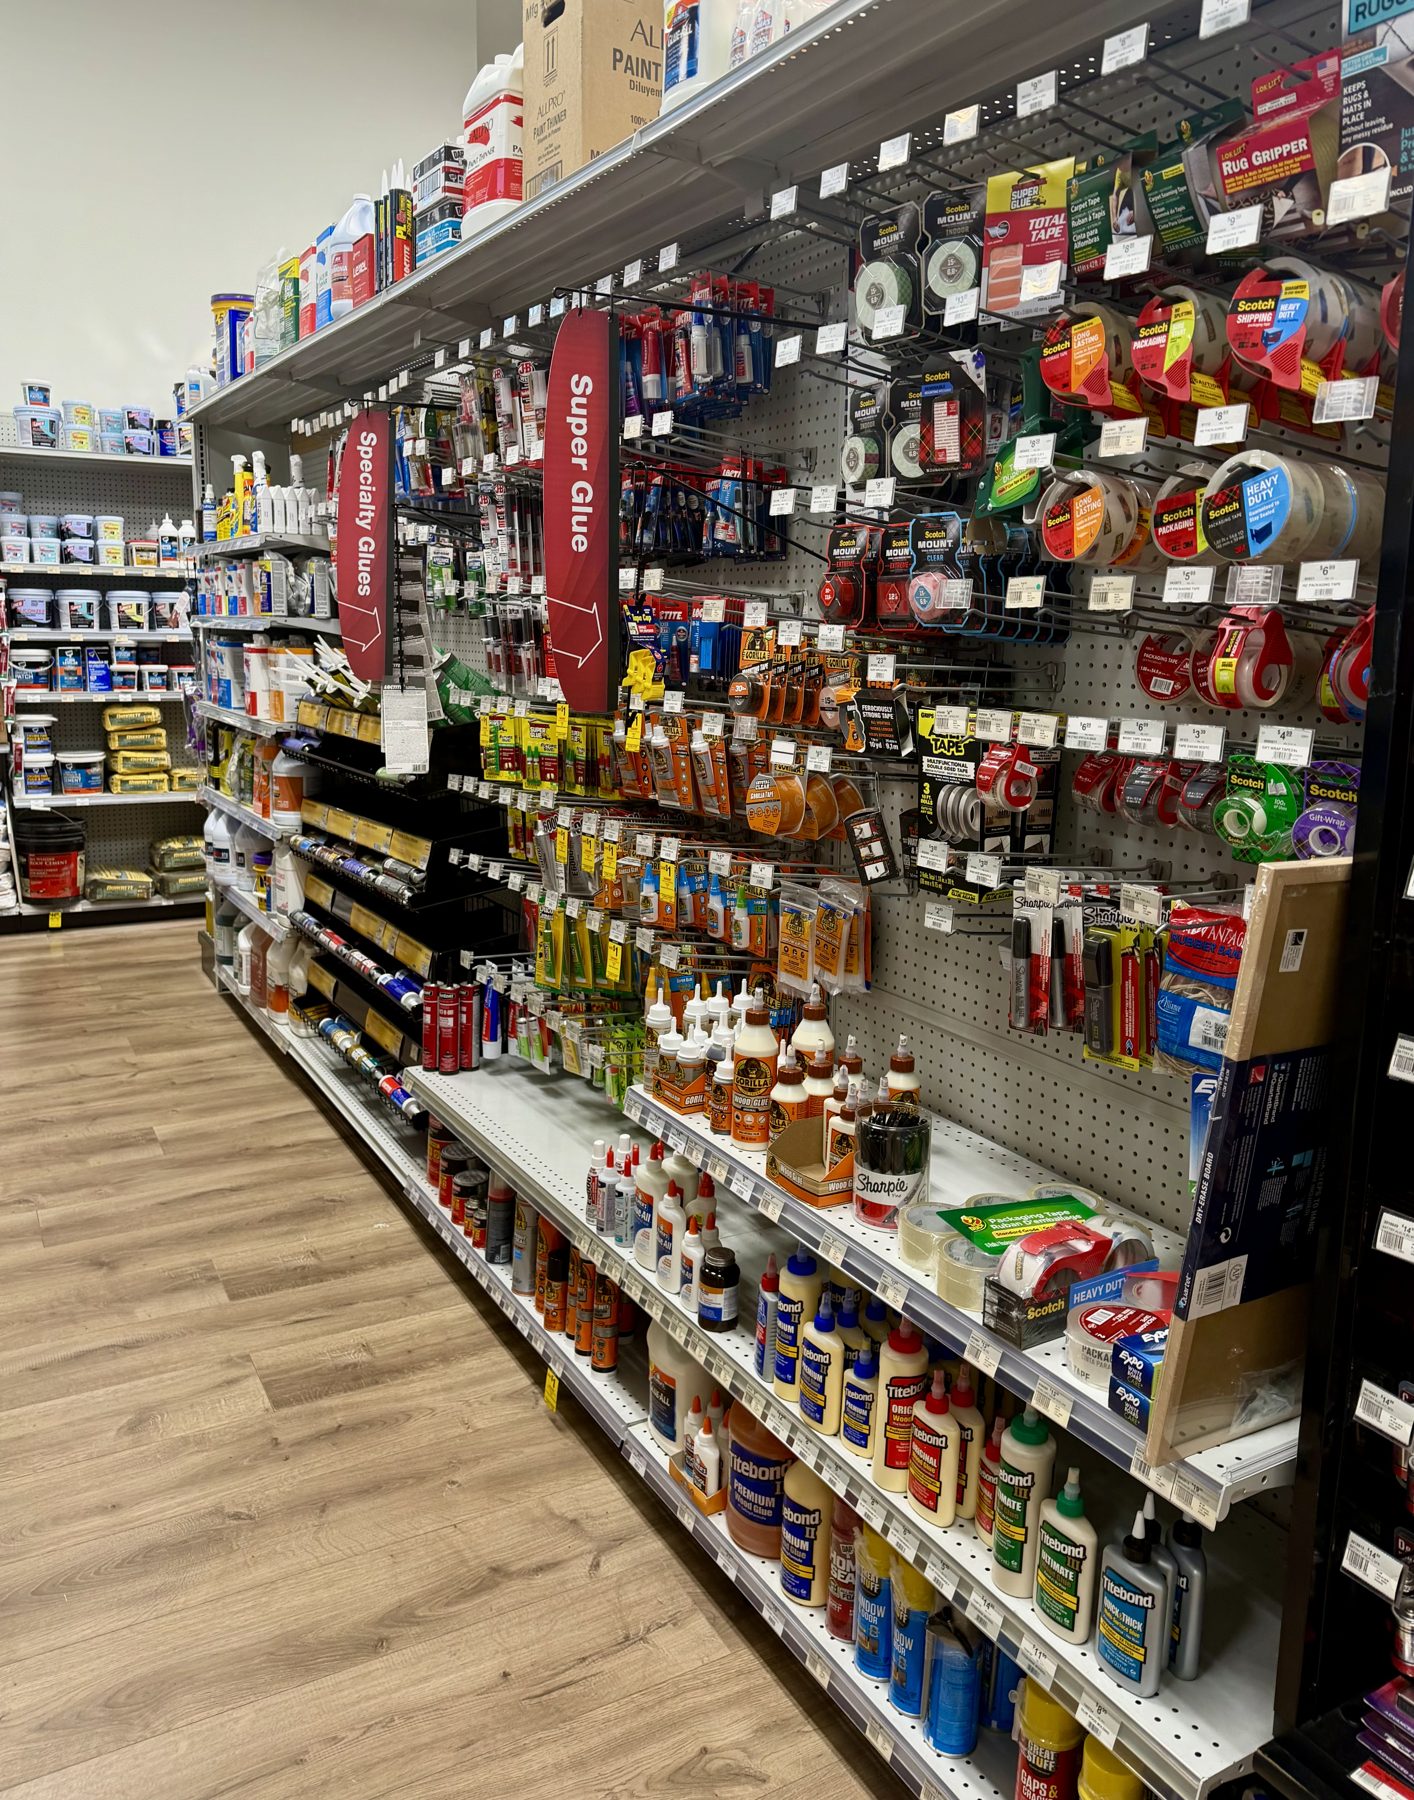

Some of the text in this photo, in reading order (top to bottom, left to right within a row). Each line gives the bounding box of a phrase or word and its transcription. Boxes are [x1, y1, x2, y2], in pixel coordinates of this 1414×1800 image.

[525, 4, 539, 22] Mfg
[612, 47, 662, 82] PAINT
[1343, 80, 1366, 95] KEEPS
[537, 91, 564, 121] ALLPRO
[1343, 91, 1369, 106] RUGS &
[1342, 99, 1372, 116] MATS IN
[1342, 112, 1365, 126] PLACE
[1342, 117, 1386, 135] without leaving
[1342, 123, 1394, 145] any messy residue
[453, 151, 465, 159] DAP
[1222, 138, 1308, 176] RUG GRIPPER
[1012, 186, 1039, 201] SUPER
[946, 203, 970, 214] Scotch
[1011, 197, 1031, 210] GLUE
[1071, 197, 1101, 213] Carpet Tape
[937, 211, 978, 225] MOUNT
[1029, 213, 1066, 227] TOTAL
[1072, 210, 1106, 228] Ruban Tapis
[879, 225, 898, 236] Scotch
[1032, 227, 1063, 242] TAPE
[1073, 229, 1099, 242] Cinta para
[873, 231, 905, 247] MOUNT
[1074, 236, 1100, 249] Alfombras
[1237, 299, 1276, 312] Scotch
[1280, 302, 1301, 313] HEAVY
[1236, 312, 1273, 324] SHIPPING
[1278, 310, 1295, 318] DUTY
[1074, 330, 1091, 342] LONG
[1139, 322, 1169, 338] Scotch
[1042, 340, 1071, 357] Scotch
[1074, 335, 1099, 348] LASTING
[1133, 335, 1167, 350] PACKAGING
[925, 371, 950, 382] Scotch
[859, 398, 876, 408] Scotch
[854, 406, 881, 418] MOUNT
[566, 373, 594, 553] Super Glue
[1246, 474, 1279, 497] HEAVY
[1075, 495, 1092, 508] LONG
[1248, 487, 1275, 507] DUTY
[355, 431, 378, 596] Specialty Glues
[1075, 500, 1102, 518] LASTING
[1162, 506, 1194, 524] Scotch
[1208, 501, 1239, 520] Scotch
[1047, 513, 1071, 528] Scotch
[1158, 518, 1194, 536] PACKAGING
[925, 530, 946, 540] Scotch
[839, 539, 856, 548] Scotch
[917, 539, 953, 549] MOUNT
[832, 547, 861, 557] MOUNT
[743, 650, 768, 661] GORILLA
[1143, 652, 1178, 666] PACKAGING TAPE
[861, 704, 893, 714] FEROCIOUSLY
[862, 711, 894, 720] STRONG TAPE
[931, 737, 964, 753] TAPE
[755, 783, 771, 791] CLEAR
[923, 783, 931, 795] 3
[1230, 774, 1265, 790] Scotch
[1310, 784, 1358, 803] Scotch
[1309, 813, 1346, 828] Gift-Wrap
[1013, 896, 1051, 910] Sharpie
[1171, 933, 1217, 953] RUBBER
[736, 1078, 769, 1088] GORILLA
[734, 1095, 768, 1107] WOOD GLUE
[828, 1180, 848, 1192] WOOD
[856, 1173, 909, 1198] Sharpie
[1195, 1151, 1215, 1225] DRY-ERASE BOARD
[989, 1208, 1072, 1227] Packaging Tape
[990, 1212, 1083, 1231] Ruban D'emballage
[1072, 1283, 1104, 1305] HEAVY
[1180, 1273, 1192, 1308] Quartet
[1026, 1298, 1066, 1321] Scotch
[1118, 1350, 1145, 1370] EXPO
[1126, 1370, 1142, 1384] BOARD
[1127, 1364, 1144, 1376] WHITE
[845, 1387, 873, 1401] Titebond
[887, 1380, 927, 1399] Titebo
[1115, 1386, 1141, 1408] EXPO
[846, 1400, 868, 1416] PREMIUM
[1123, 1400, 1140, 1414] WHITE
[1123, 1405, 1139, 1420] BOARD
[730, 1449, 792, 1482] Titebond
[733, 1479, 776, 1508] PREMIUM
[734, 1491, 773, 1518] Wood Glue
[1041, 1528, 1084, 1559] Titebond
[1041, 1548, 1075, 1582] ULTIMATE
[1103, 1575, 1153, 1608] Titebond
[1103, 1595, 1144, 1633] QUICK THICK
[1027, 1740, 1057, 1762] GREAT
[1026, 1751, 1057, 1772] STUFF
[1020, 1769, 1058, 1799] GAPS &
